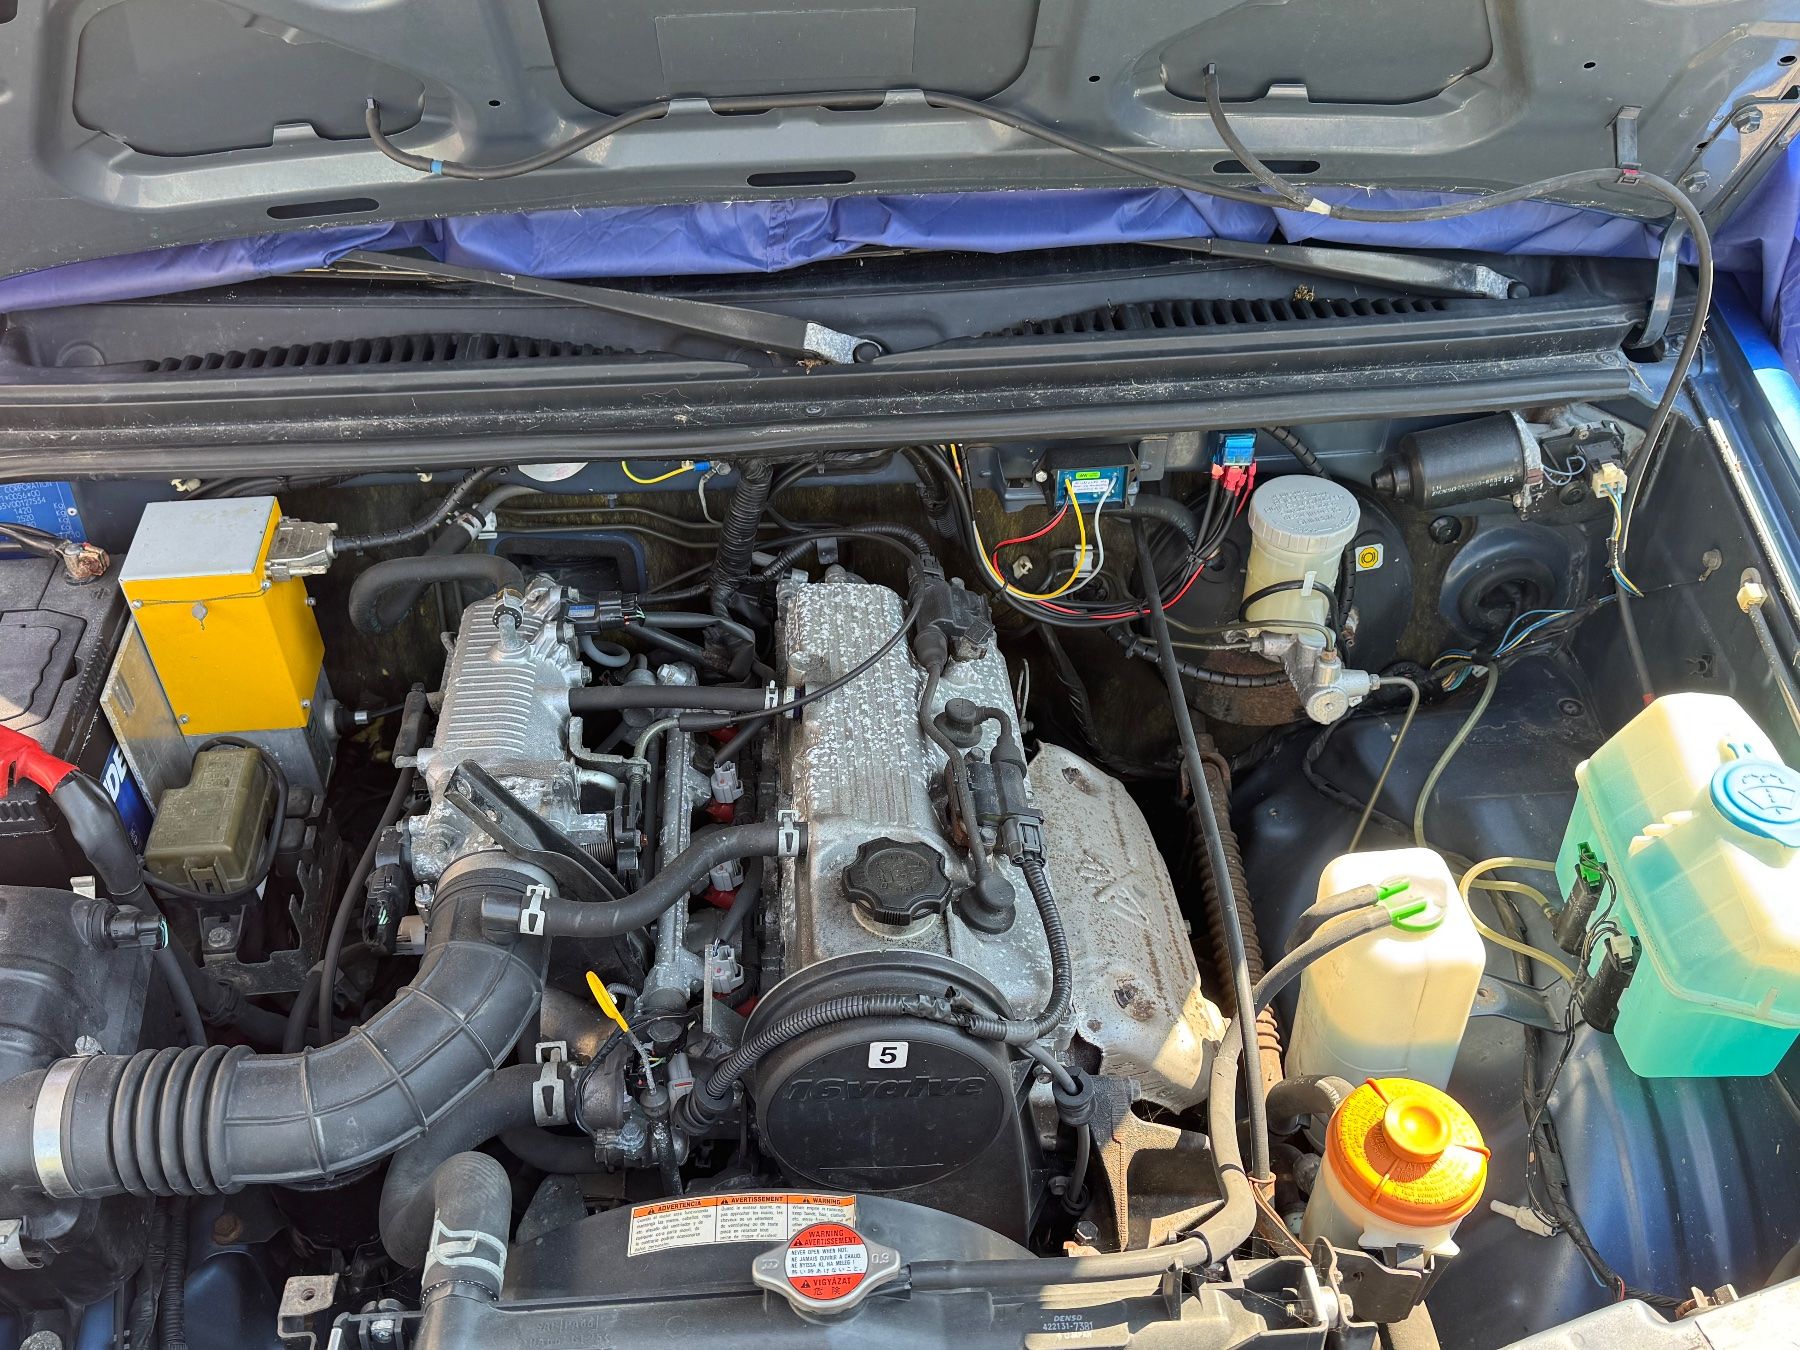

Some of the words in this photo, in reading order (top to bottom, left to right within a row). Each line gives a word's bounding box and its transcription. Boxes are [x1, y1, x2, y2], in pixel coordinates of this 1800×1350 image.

[5, 482, 52, 493] CORPORATION
[14, 506, 32, 515] 1420
[16, 514, 34, 522] 2520
[879, 1047, 897, 1063] 5
[788, 1076, 986, 1101] 16valve
[658, 1201, 701, 1211] ADVERTENCIA
[809, 1230, 844, 1238] WARNING
[804, 1237, 856, 1245] AVERTISSEMENT
[813, 1277, 852, 1285] VIGYÁZAT
